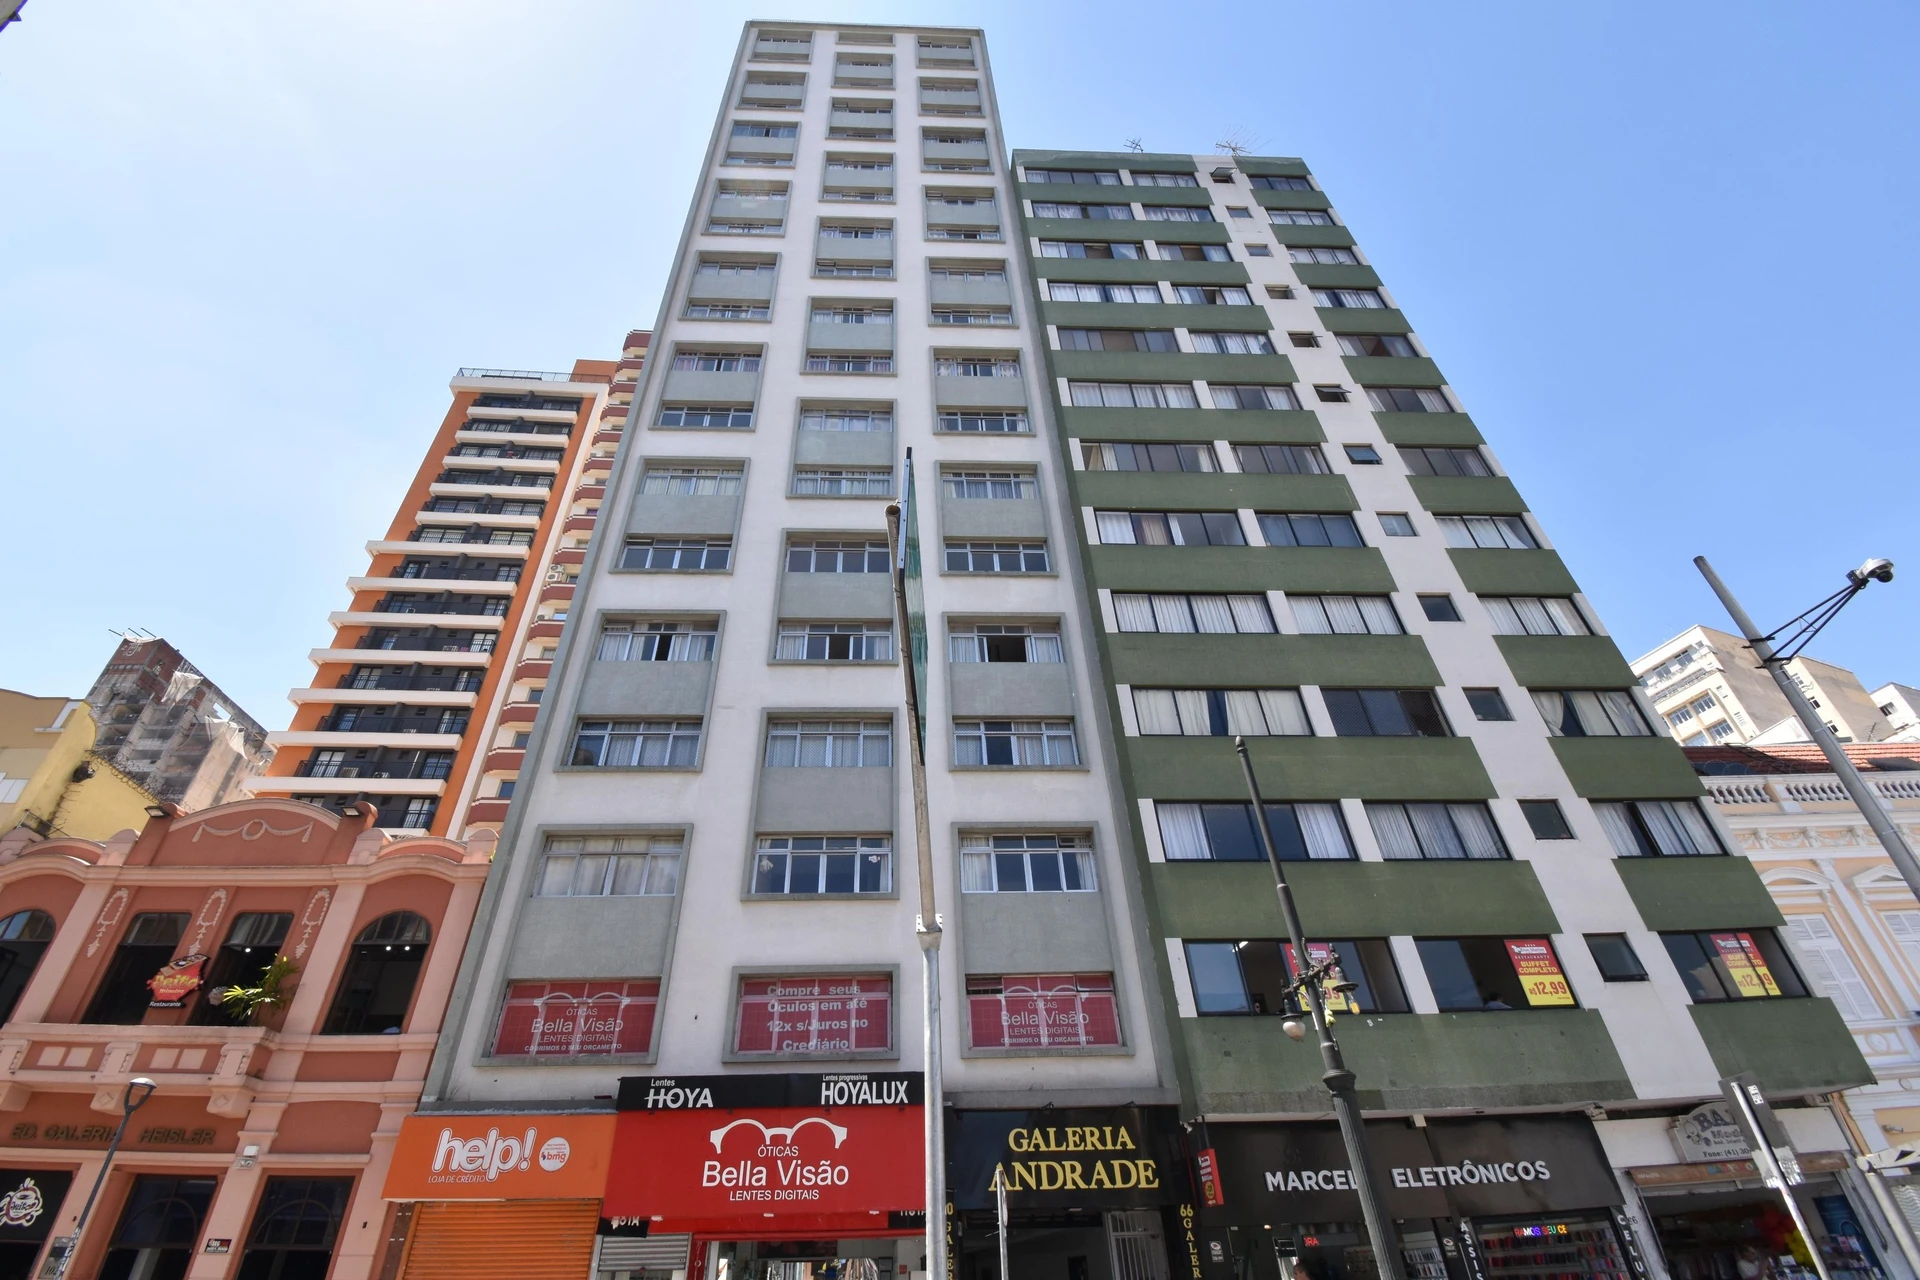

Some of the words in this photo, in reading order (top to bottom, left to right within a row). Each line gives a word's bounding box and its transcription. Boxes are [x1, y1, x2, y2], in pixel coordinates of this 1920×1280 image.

[767, 985, 820, 996] Compre
[829, 985, 861, 995] seus
[767, 999, 815, 1012] Óculos
[821, 1002, 841, 1011] em
[846, 998, 868, 1009] até
[1028, 1000, 1058, 1009] ÓTICAS
[566, 1008, 598, 1016] ÓTICAS
[1001, 1011, 1039, 1025] Bella
[1043, 1010, 1090, 1024] Visão
[531, 1018, 573, 1033] Bella
[580, 1017, 624, 1032] Visão
[767, 1020, 792, 1032] 12x
[796, 1019, 848, 1031] s/Juros
[851, 1019, 868, 1028] no
[1009, 1027, 1043, 1036] LENTES
[1045, 1026, 1081, 1034] DIGITAIS
[538, 1035, 574, 1043] LENTES
[576, 1033, 614, 1042] DIGITAIS
[782, 1038, 849, 1051] Crediário
[651, 1078, 676, 1087] Lentes
[644, 1088, 714, 1108] HOYA
[821, 1081, 909, 1105] HOYALUX
[44, 1126, 122, 1141] GALERIA
[139, 1129, 215, 1144] HEISLER
[1008, 1126, 1136, 1152] GALERIA
[431, 1127, 538, 1182] help!
[758, 1144, 799, 1157] ÓTICAS
[546, 1152, 567, 1163] bmg
[428, 1175, 445, 1183] LOJA
[446, 1175, 456, 1183] DE
[456, 1173, 486, 1183] CRÉDITO
[702, 1160, 768, 1187] Bella
[777, 1159, 849, 1186] Visão
[988, 1160, 1160, 1191] ANDRADE
[1391, 1160, 1551, 1188] ELETRÔNICOS
[730, 1190, 772, 1201] LENTES
[774, 1189, 820, 1200] DIGITAIS
[1180, 1204, 1193, 1217] 66
